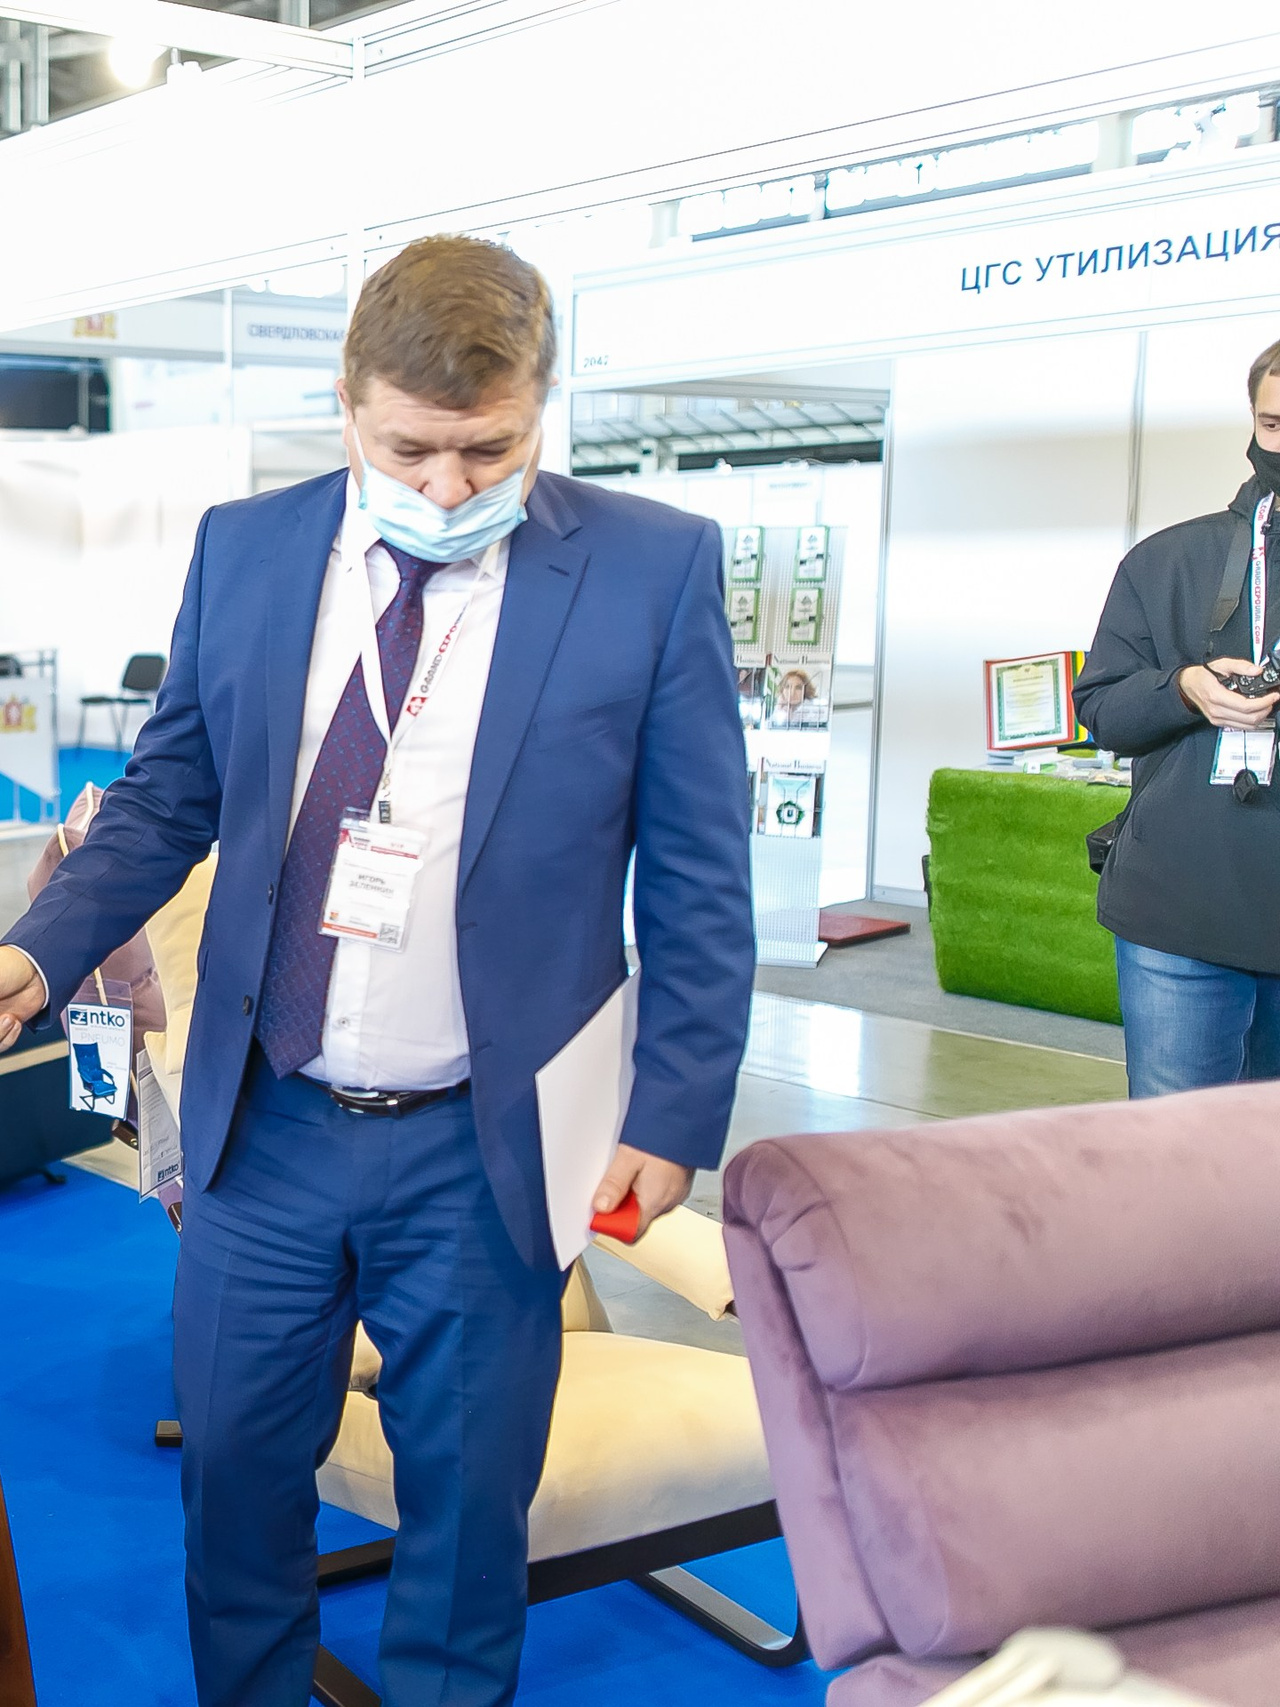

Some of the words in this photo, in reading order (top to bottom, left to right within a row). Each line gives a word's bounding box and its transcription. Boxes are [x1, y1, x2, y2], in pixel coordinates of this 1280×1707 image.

[961, 261, 1023, 294] ЦГС
[1035, 222, 1280, 282] УТИЛИЗАЦИЯ
[89, 1010, 126, 1028] ntko
